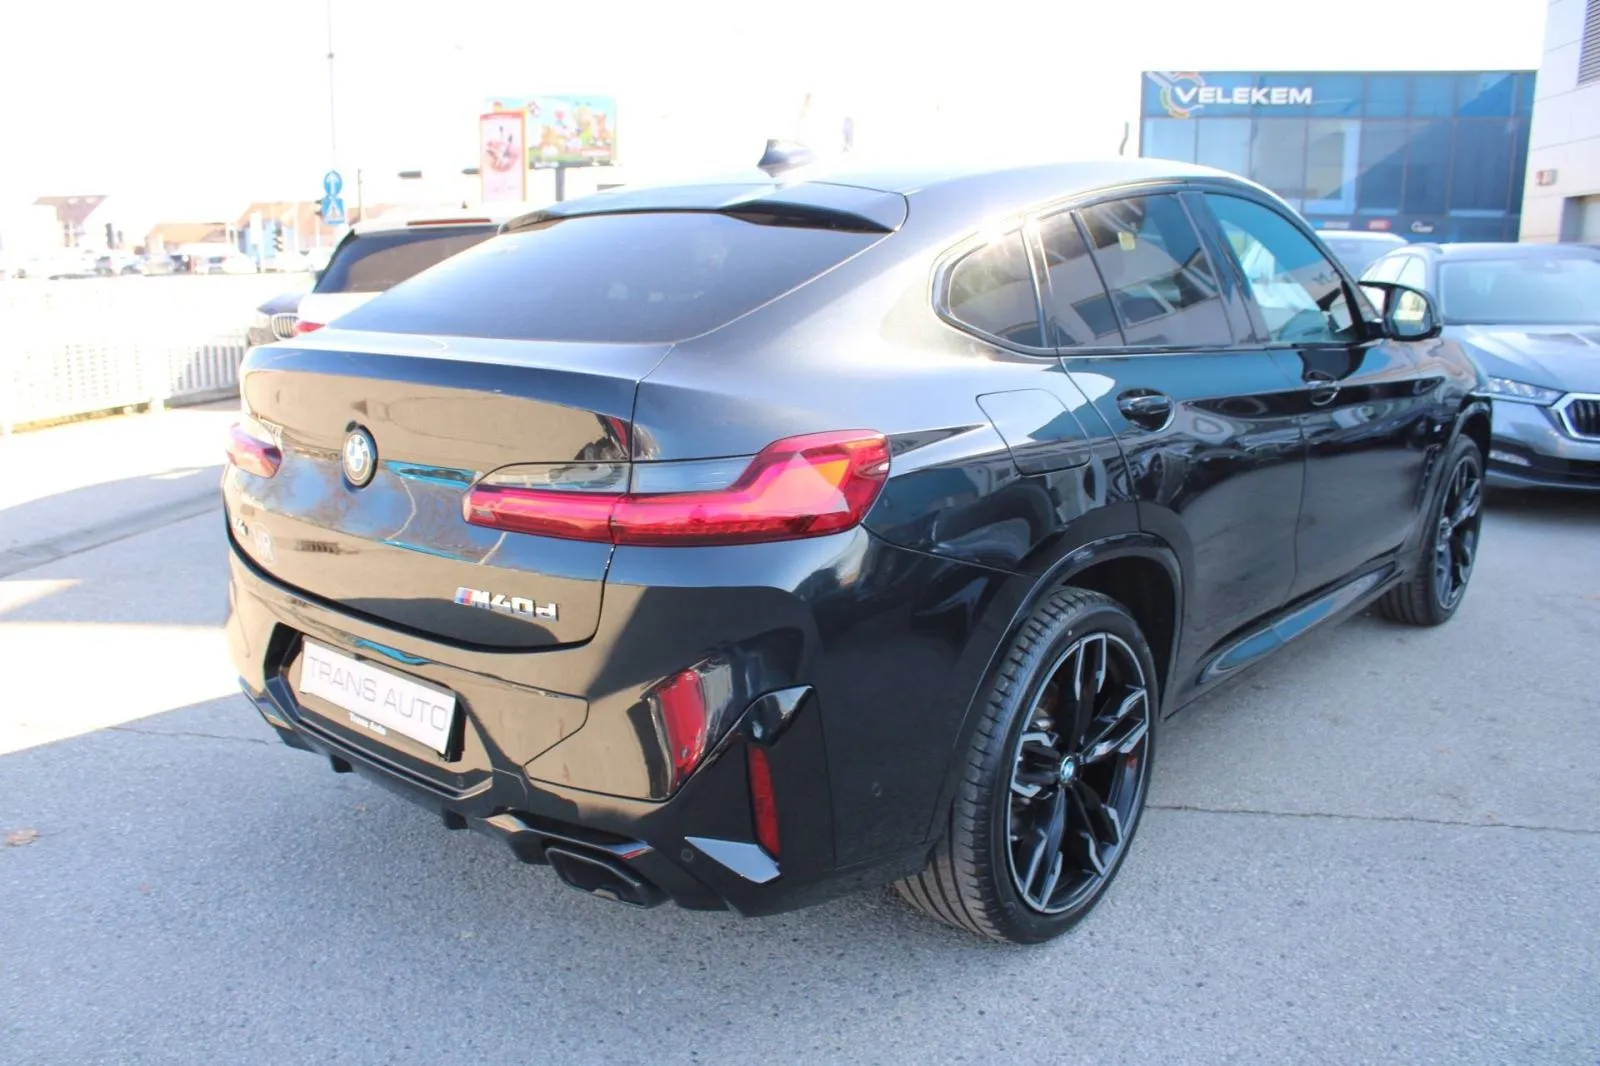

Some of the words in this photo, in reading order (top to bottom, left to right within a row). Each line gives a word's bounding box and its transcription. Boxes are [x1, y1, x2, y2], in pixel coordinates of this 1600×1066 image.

[1174, 86, 1313, 105] VELEKEM
[308, 655, 377, 702] TRANS
[383, 687, 448, 732] AUTO
